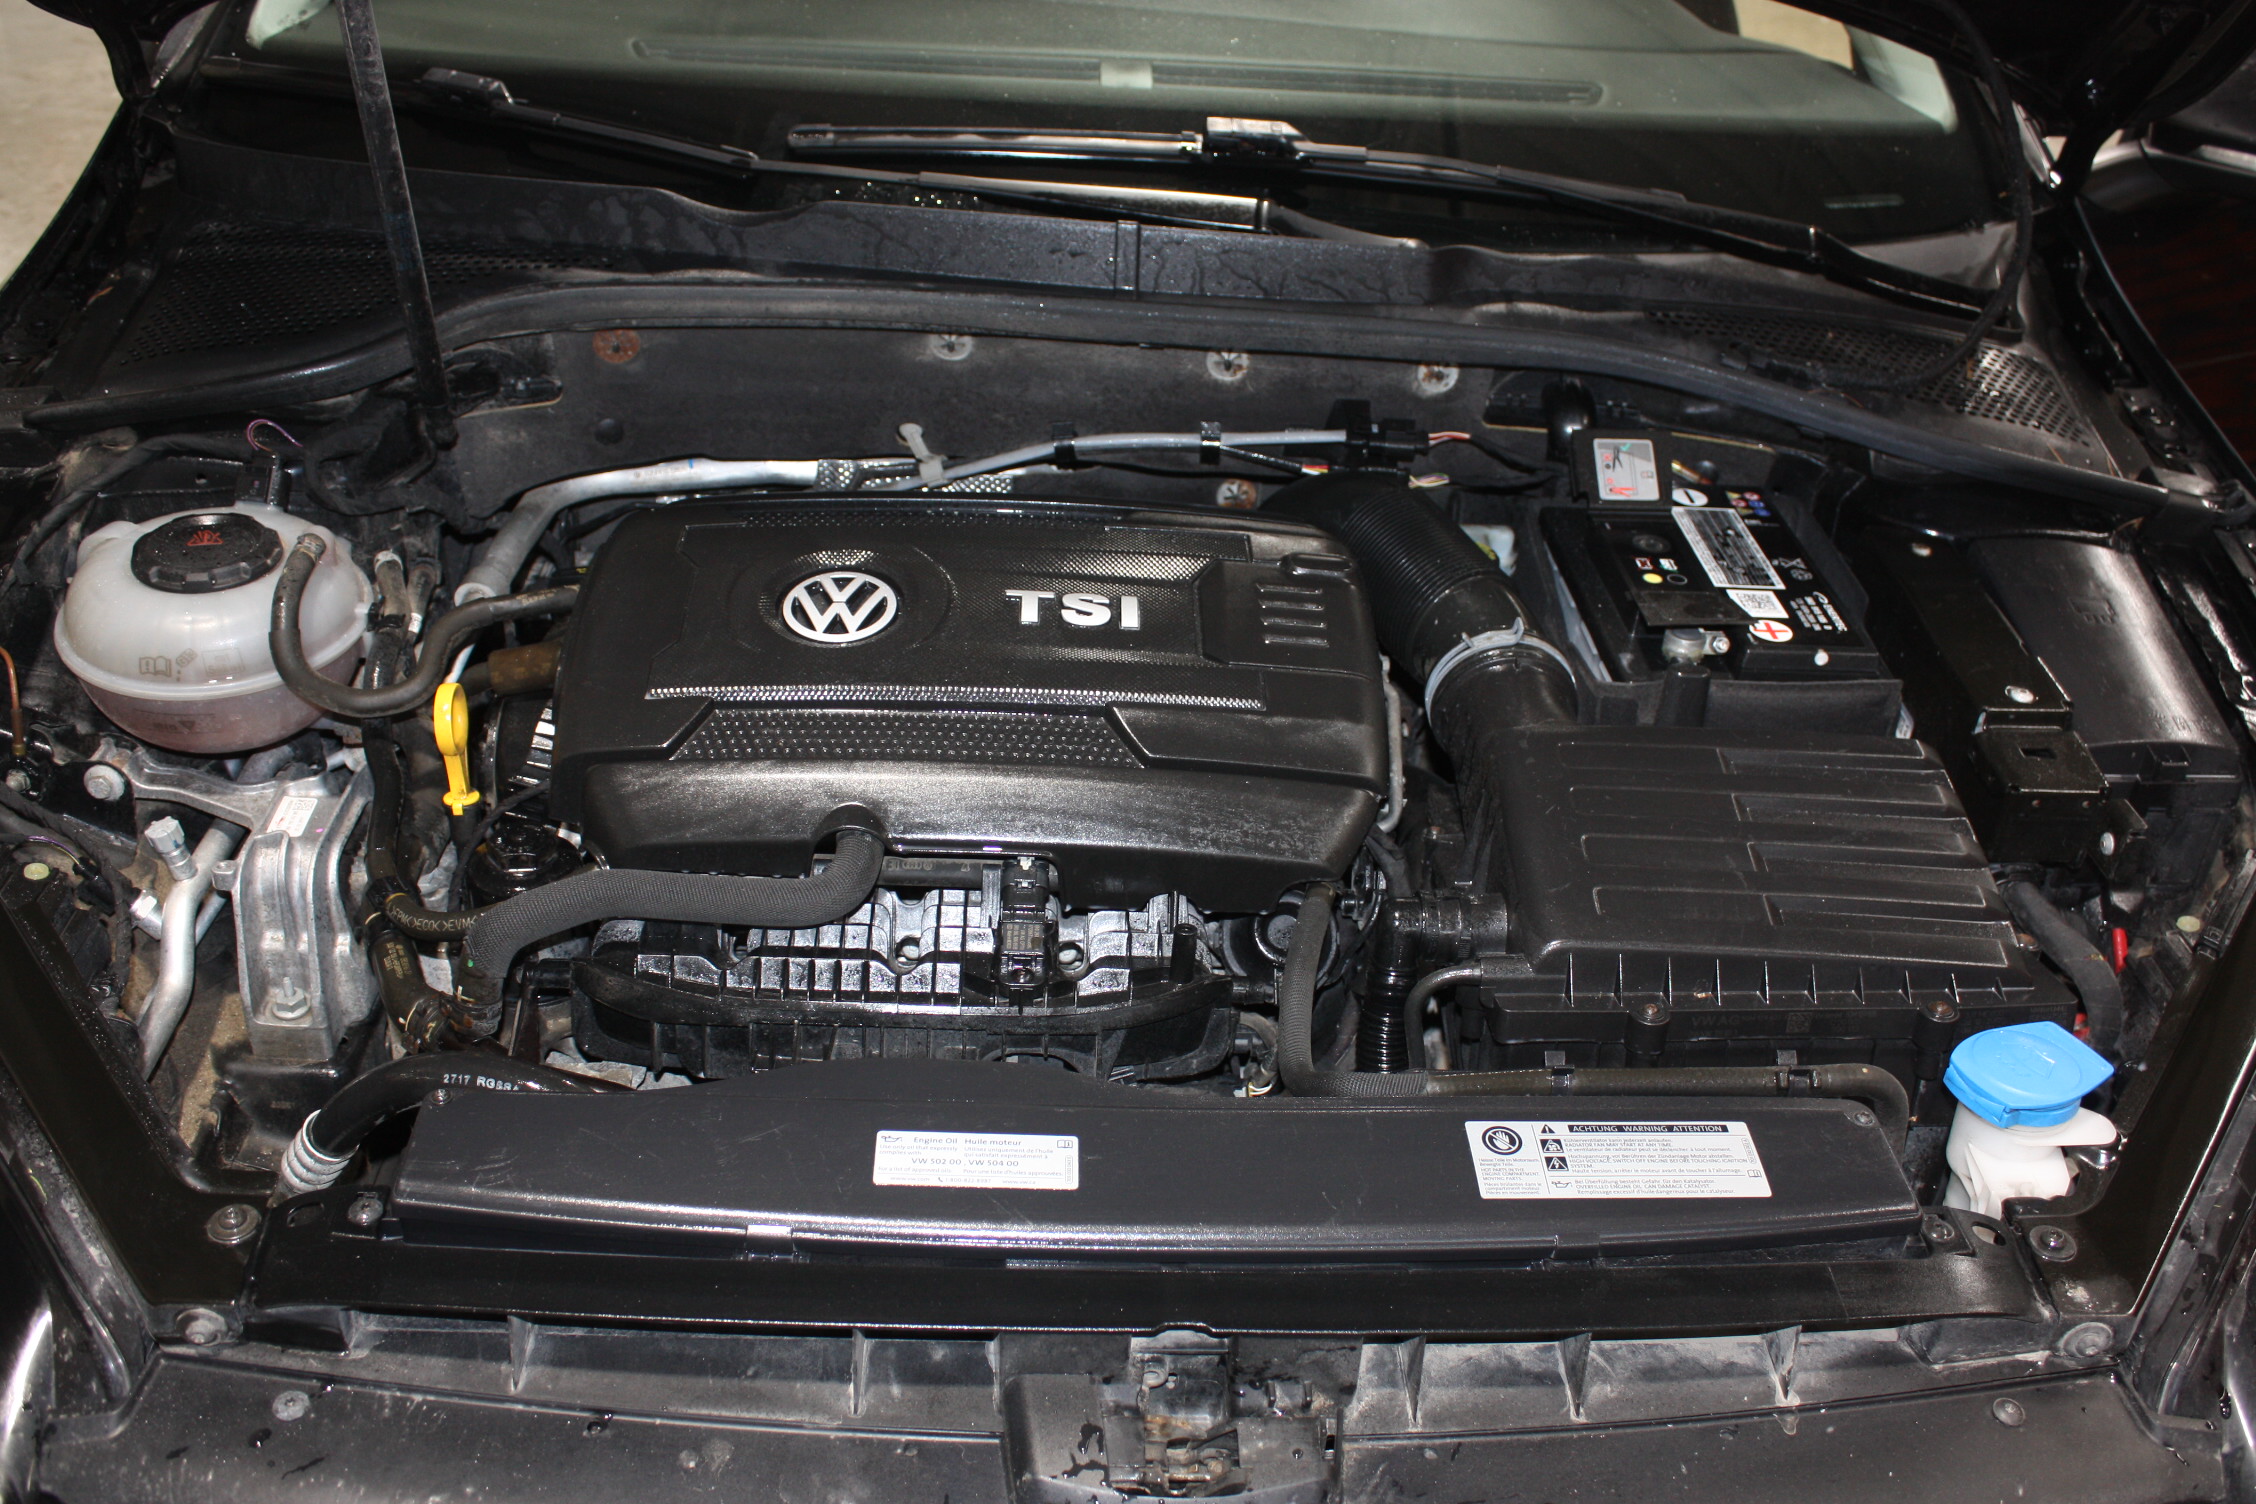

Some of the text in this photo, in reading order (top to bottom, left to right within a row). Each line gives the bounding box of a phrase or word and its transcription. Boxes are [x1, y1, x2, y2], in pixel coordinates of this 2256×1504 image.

[782, 571, 897, 643] VW
[1005, 588, 1141, 630] TSI
[443, 1073, 471, 1086] 2717
[914, 1137, 943, 1145] Engine
